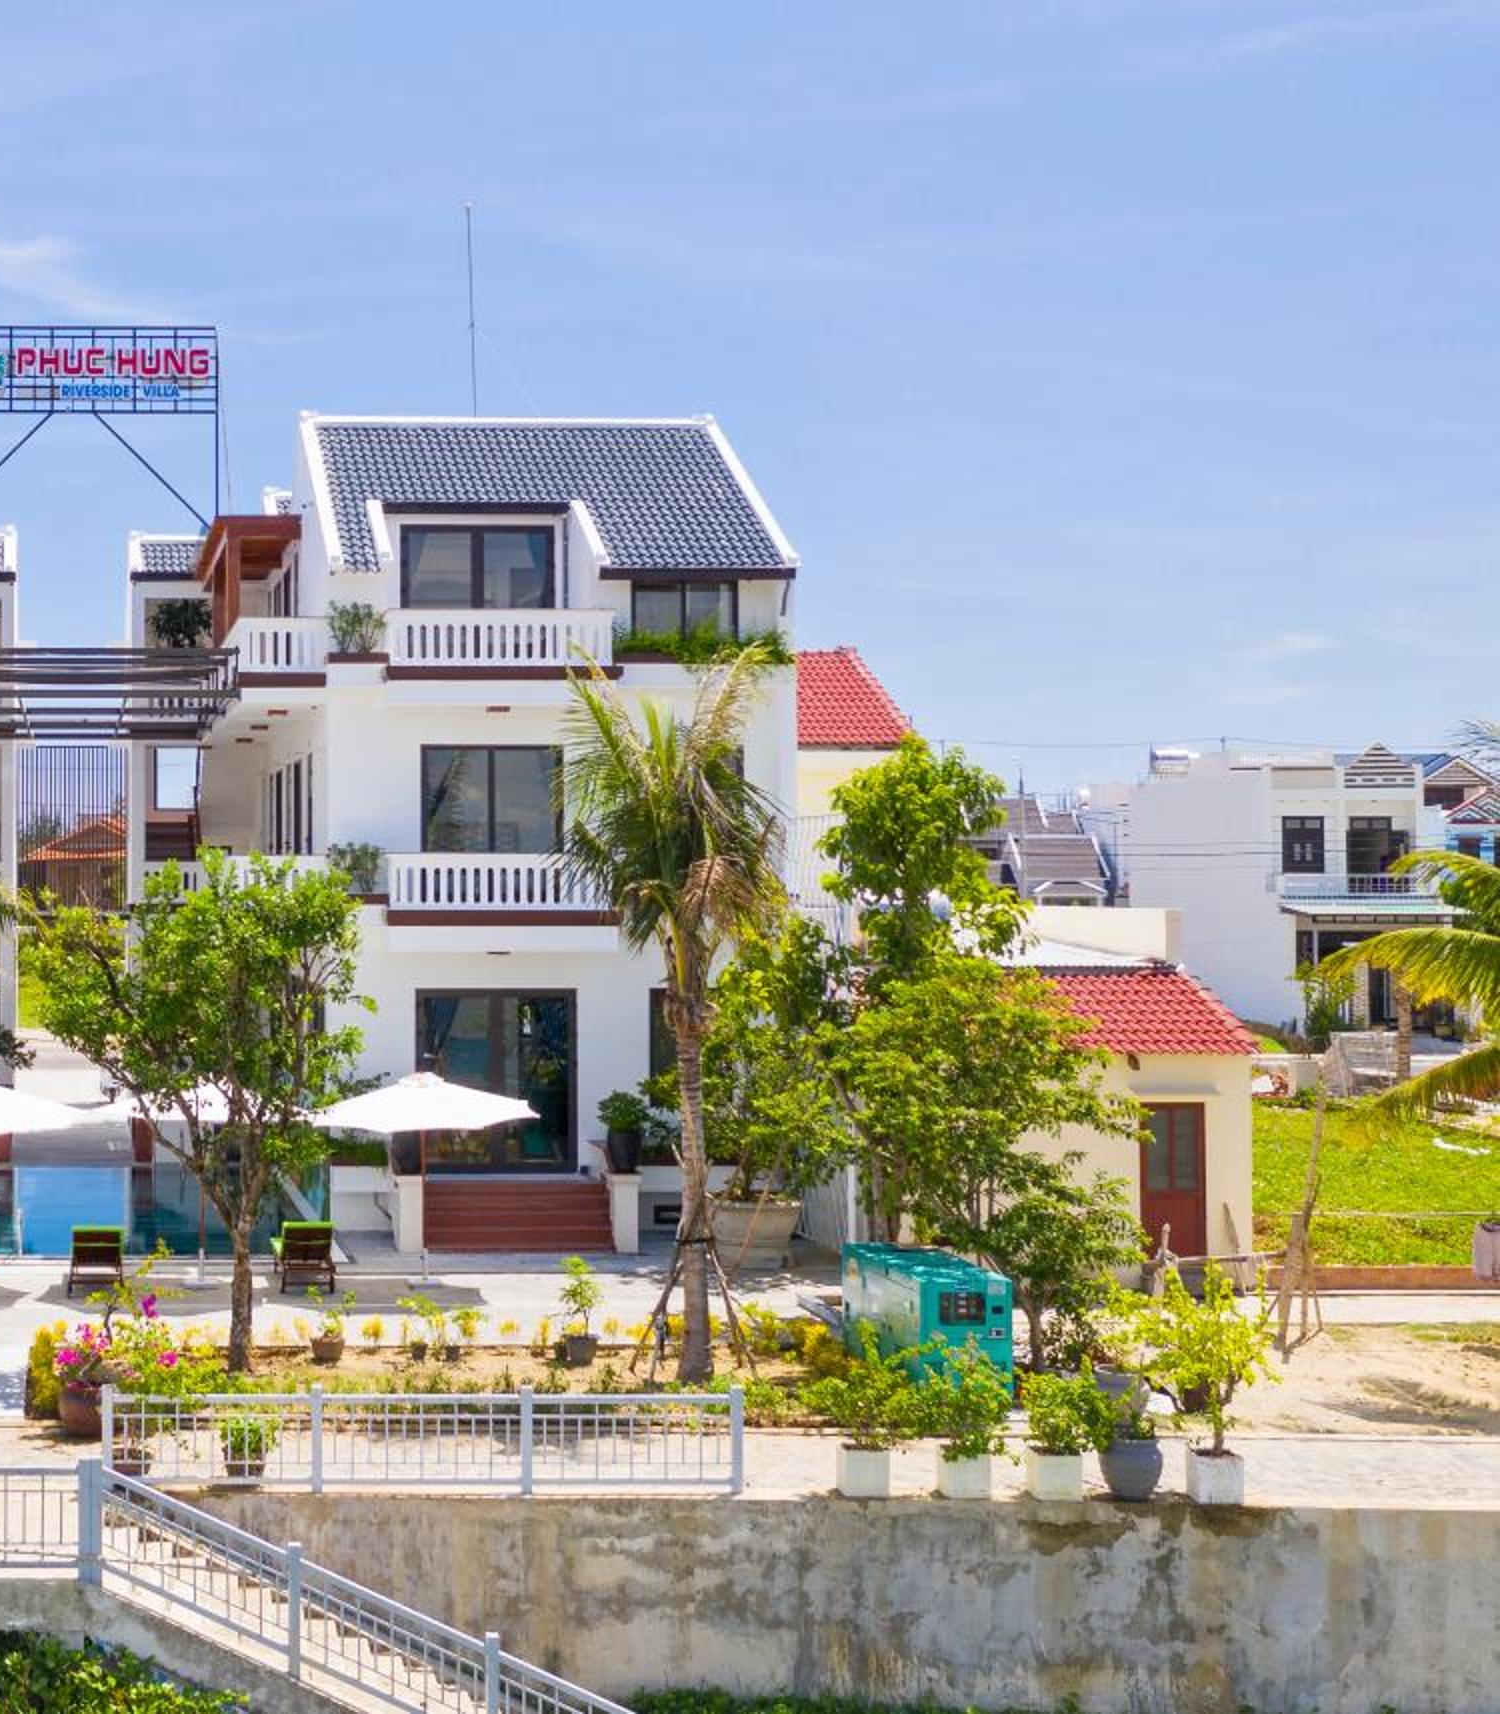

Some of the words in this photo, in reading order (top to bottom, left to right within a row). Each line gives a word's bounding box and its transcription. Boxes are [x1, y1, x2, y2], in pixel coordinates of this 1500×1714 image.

[17, 348, 105, 375] PHUC
[116, 348, 210, 375] HUNG
[61, 384, 131, 398] RIVERSIDE
[143, 384, 180, 398] VILLA
